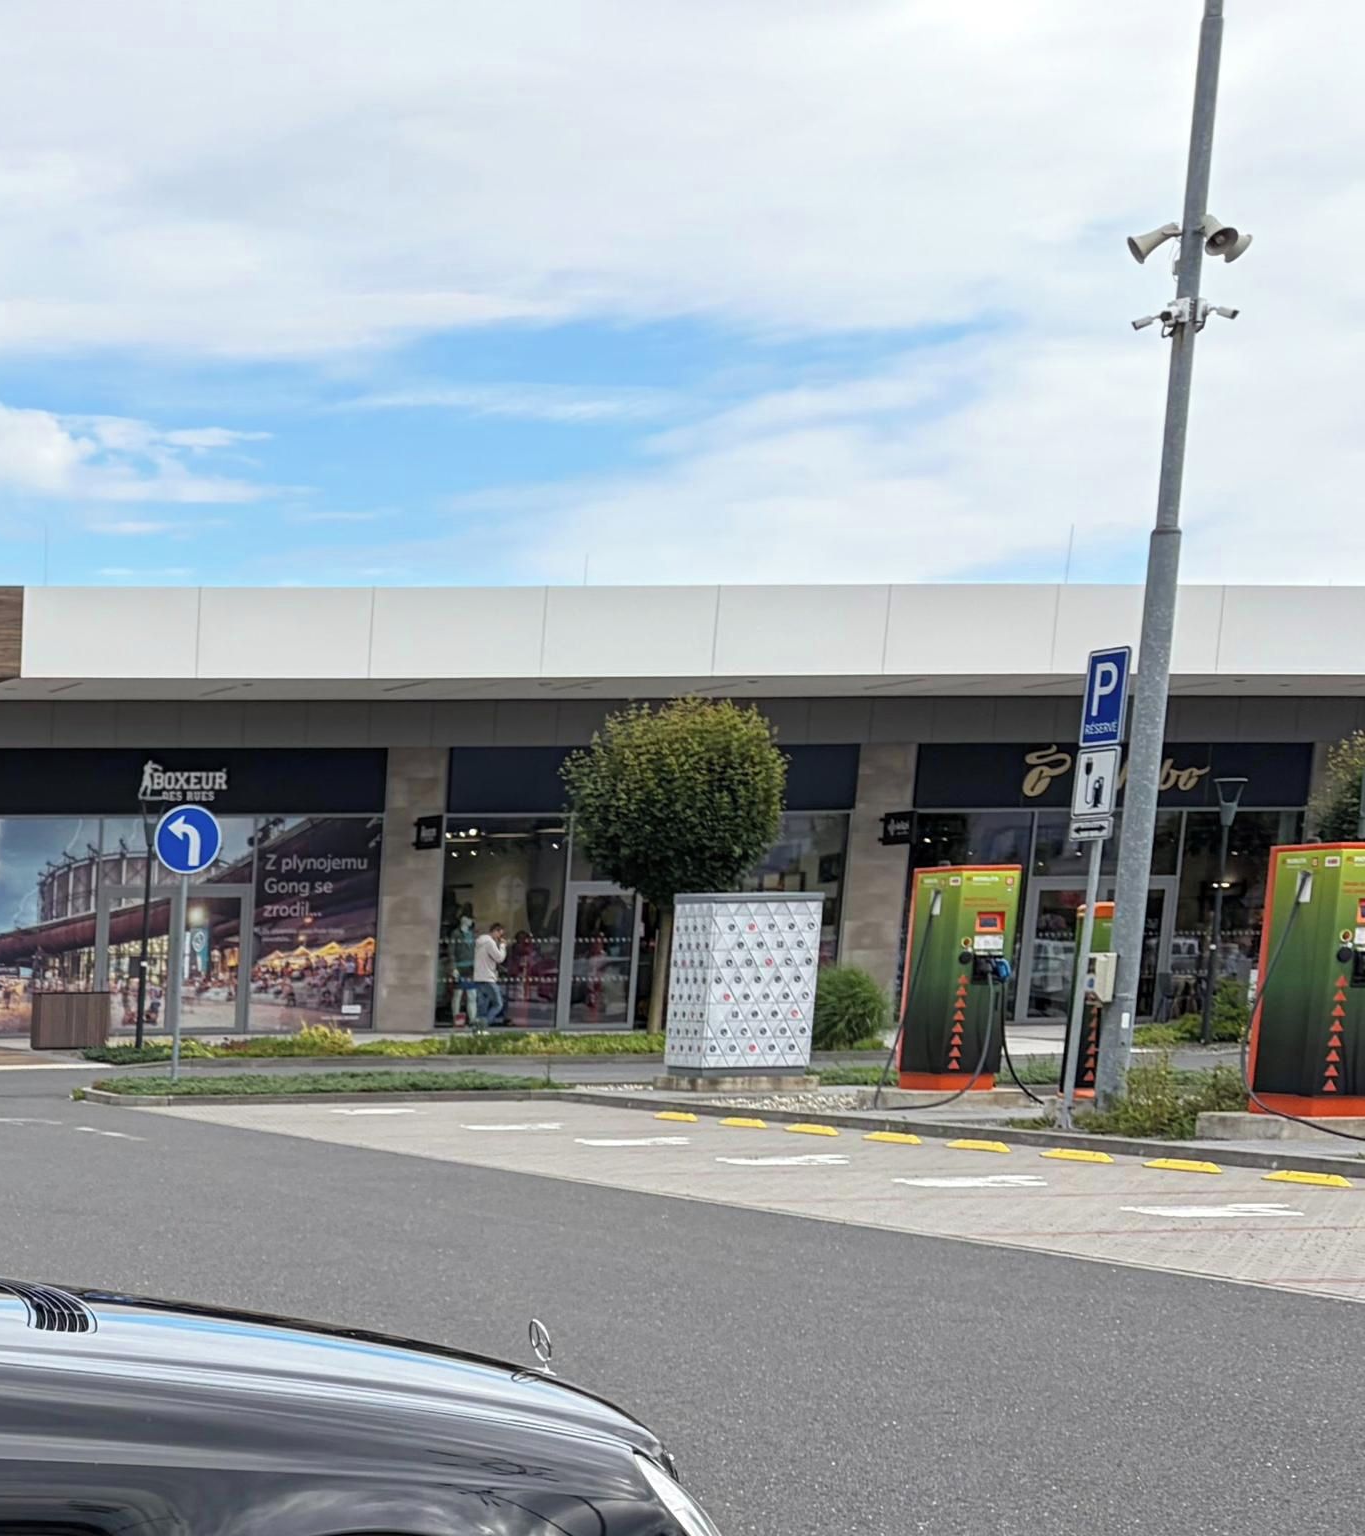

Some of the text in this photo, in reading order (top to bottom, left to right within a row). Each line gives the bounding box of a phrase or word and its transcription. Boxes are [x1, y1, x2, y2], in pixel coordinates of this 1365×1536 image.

[1091, 661, 1119, 717] P
[152, 771, 228, 790] BOXEUR
[161, 790, 215, 802] DES RUES
[264, 853, 368, 874] Z plynojemu
[263, 877, 333, 897] Gong se
